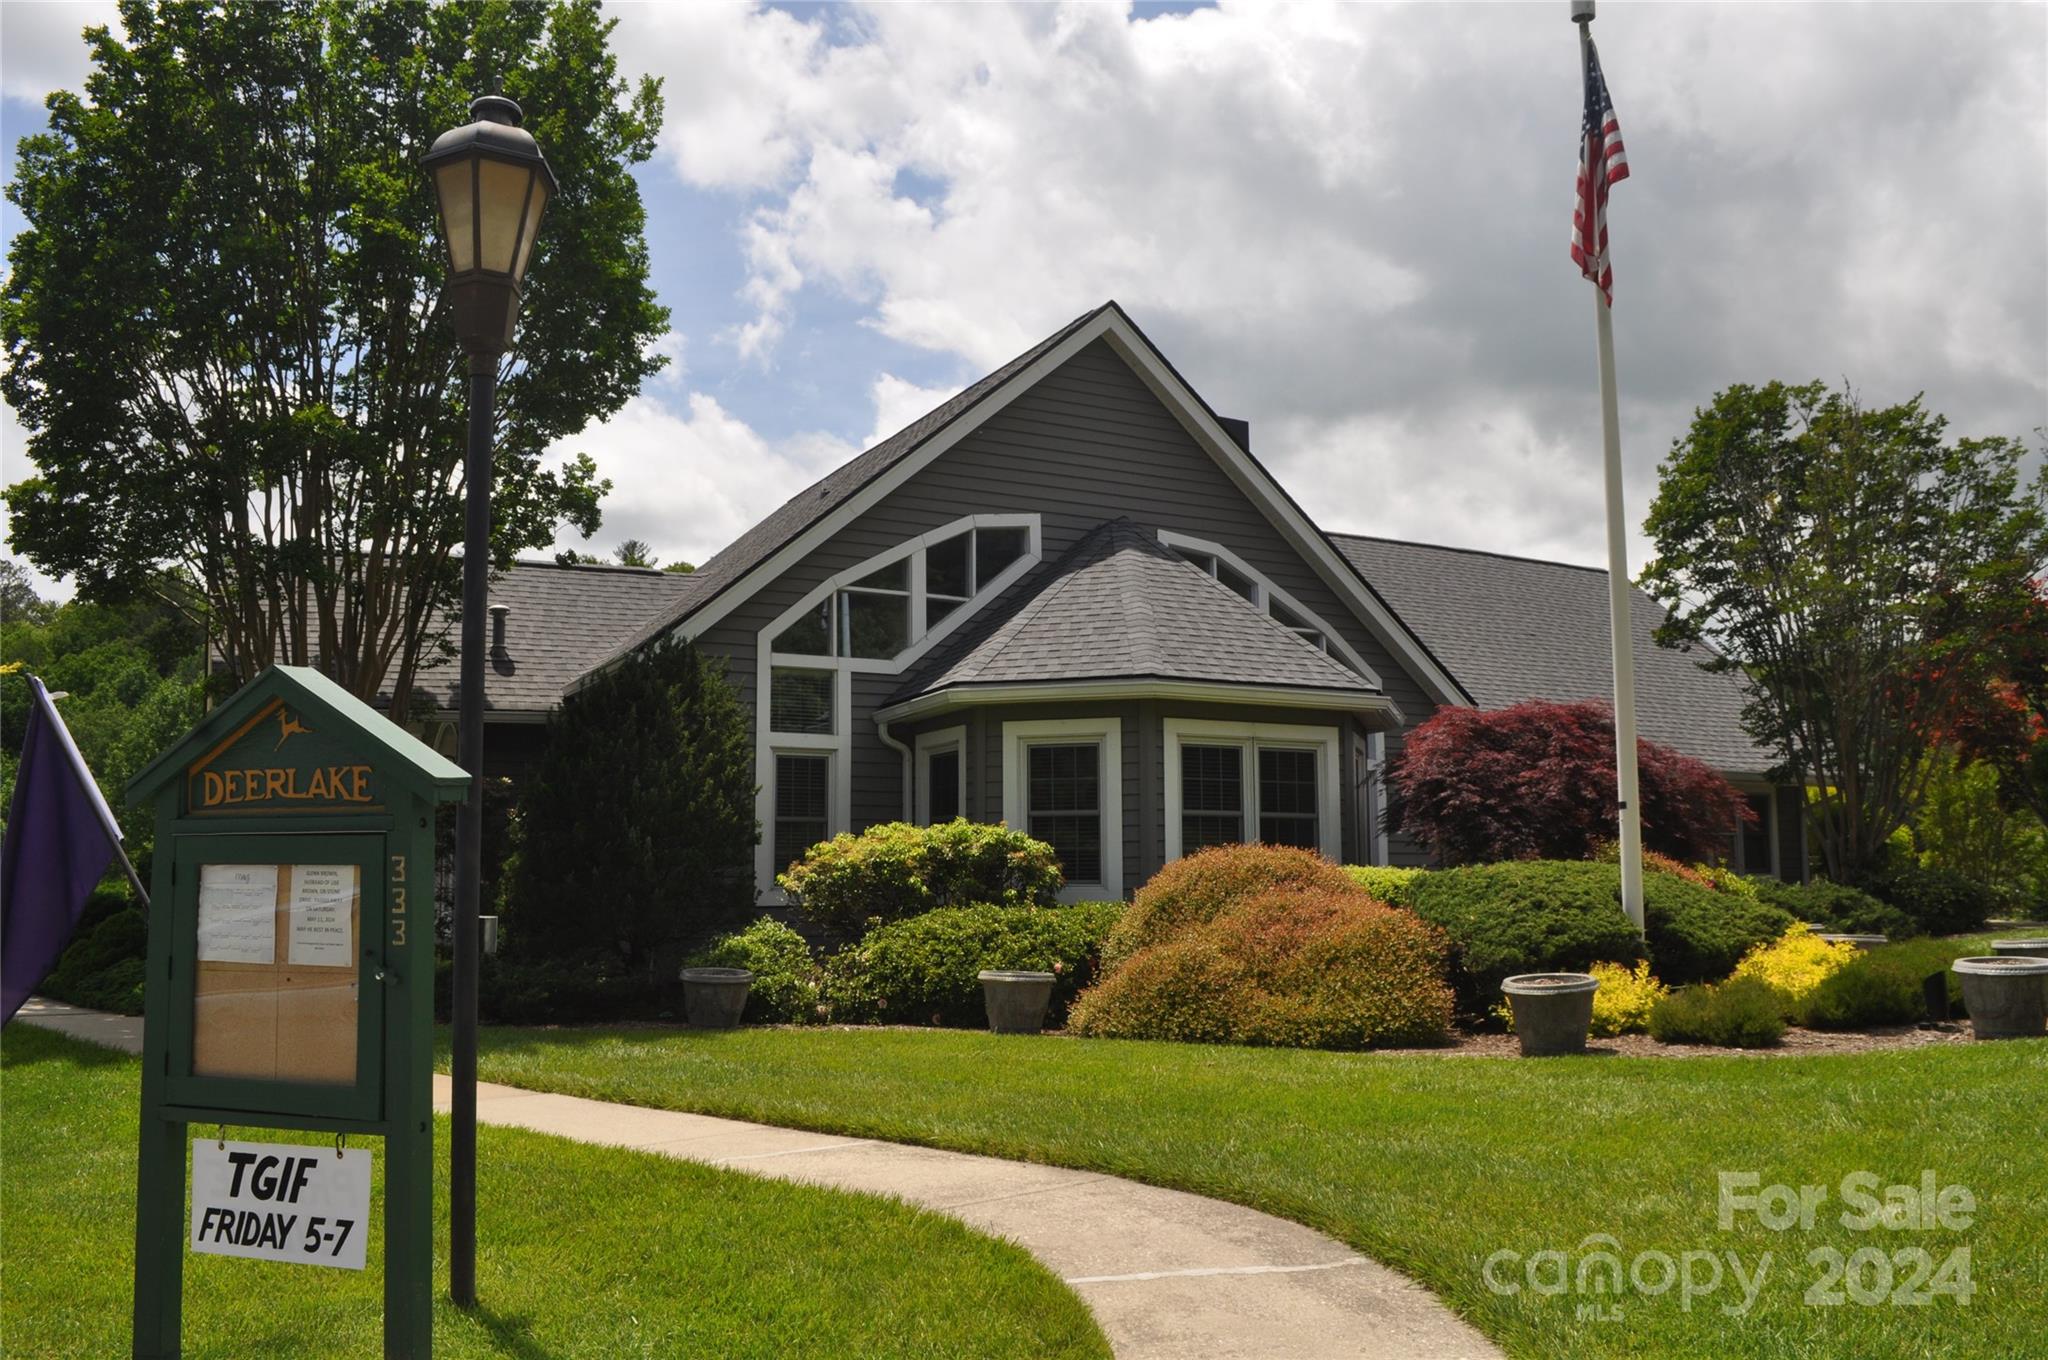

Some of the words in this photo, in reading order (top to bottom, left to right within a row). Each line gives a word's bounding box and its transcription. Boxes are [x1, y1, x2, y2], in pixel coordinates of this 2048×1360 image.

[203, 765, 373, 806] DEERLAKE
[228, 1152, 318, 1203] TGIF
[198, 1207, 297, 1250] FRIDAY
[303, 1216, 354, 1257] 5-7
